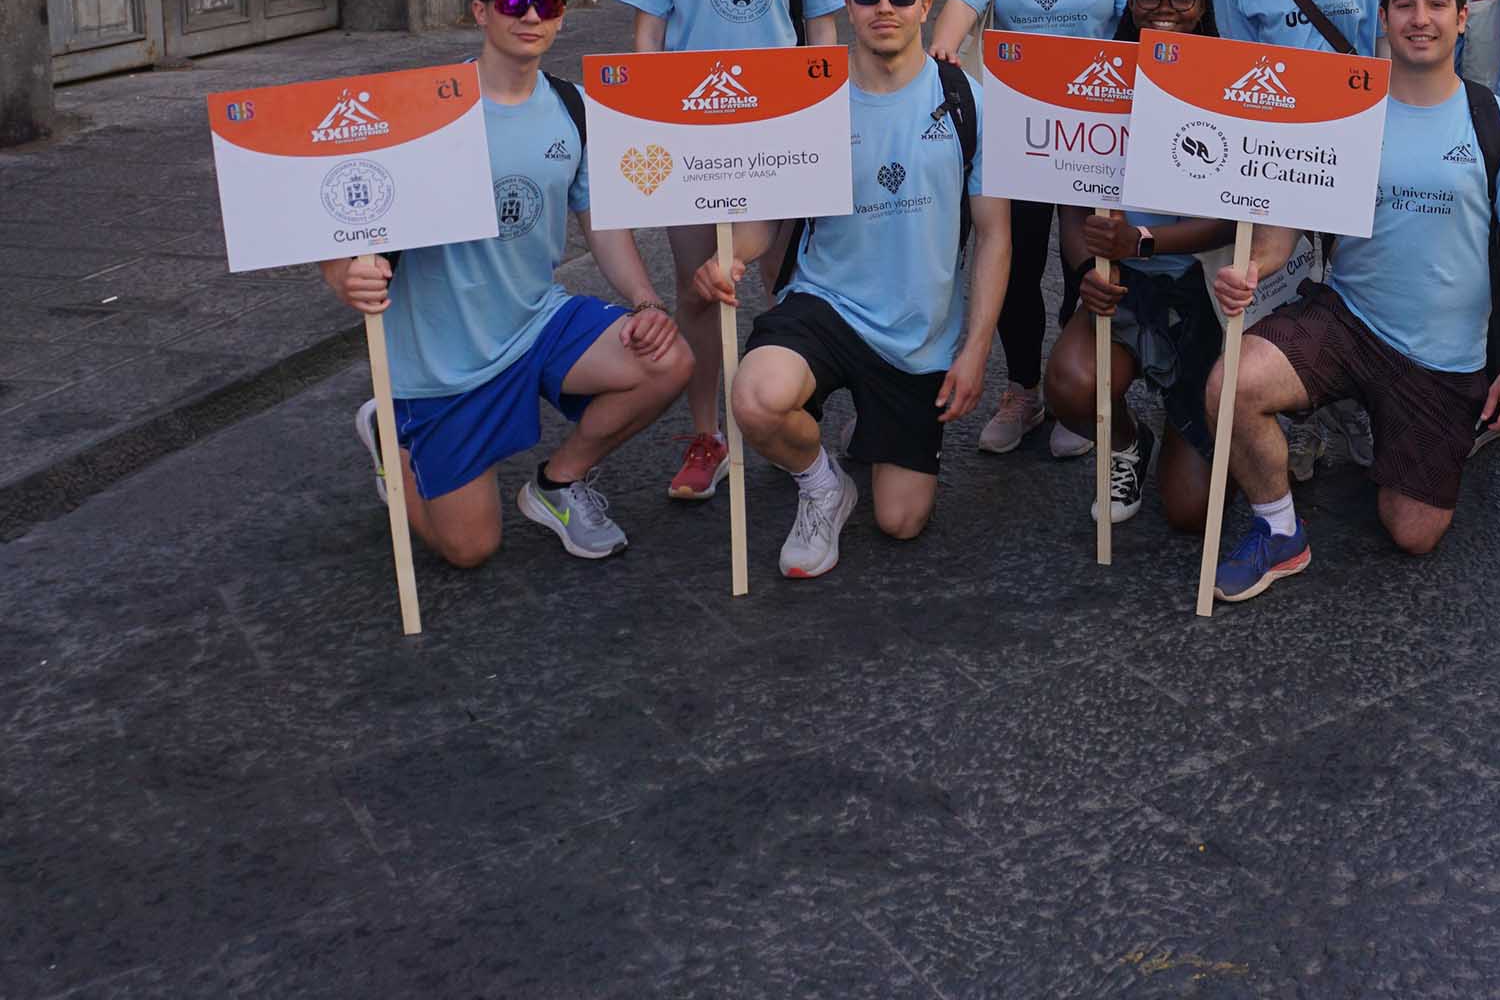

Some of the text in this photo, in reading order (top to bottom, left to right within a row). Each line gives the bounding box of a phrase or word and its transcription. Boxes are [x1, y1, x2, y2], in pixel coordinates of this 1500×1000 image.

[1066, 83, 1100, 97] XXI
[1223, 88, 1296, 104] XXI PALIO
[681, 98, 719, 111] XXI
[720, 96, 758, 104] PALIO
[311, 127, 349, 142] XXI
[1025, 117, 1130, 157] UMON
[1242, 136, 1337, 166] Università
[683, 150, 819, 170] Vaasan yliopisto
[682, 169, 777, 183] UNIVERSITY OF VAASA
[1054, 159, 1116, 178] University
[1240, 160, 1335, 188] di Catania
[1072, 180, 1120, 196] Eunice
[1391, 185, 1454, 202] Università
[694, 196, 747, 210] Eunice
[1220, 191, 1271, 209] Eunice
[1391, 199, 1452, 215] di Catania
[333, 226, 388, 243] Eunice
